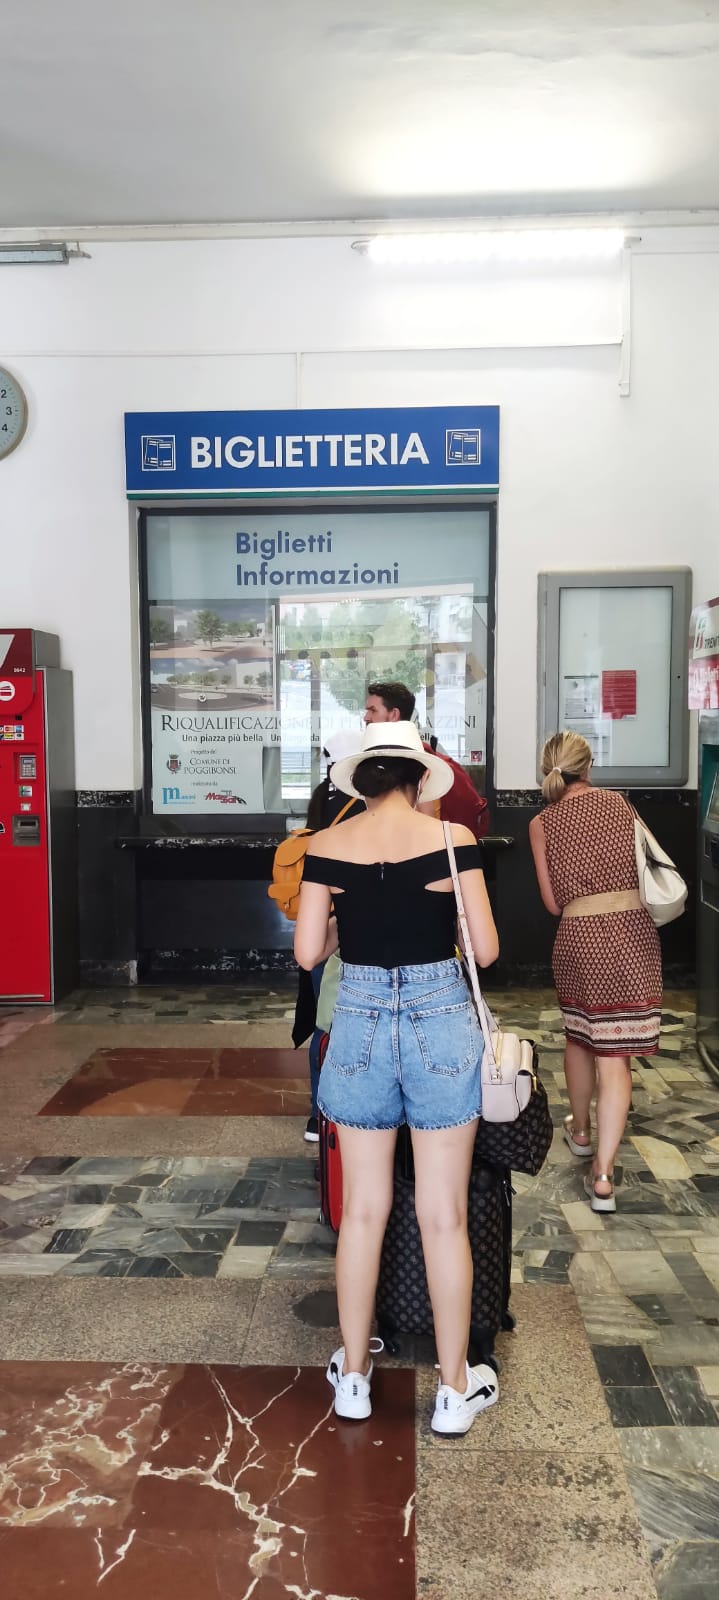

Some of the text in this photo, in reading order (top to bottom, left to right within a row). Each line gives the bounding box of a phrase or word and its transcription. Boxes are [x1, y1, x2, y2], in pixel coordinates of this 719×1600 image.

[1, 389, 7, 398] 2
[6, 407, 12, 415] 3
[2, 424, 8, 432] 4
[190, 432, 430, 469] BIGLIETTERIA
[236, 531, 333, 560] Biglietti
[236, 562, 400, 586] Informazioni
[182, 734, 198, 742] Una
[200, 734, 226, 744] piazza
[228, 734, 241, 744] più
[243, 733, 263, 742] bella
[189, 757, 221, 766] COMUNE
[184, 766, 236, 775] POGGIBONSI
